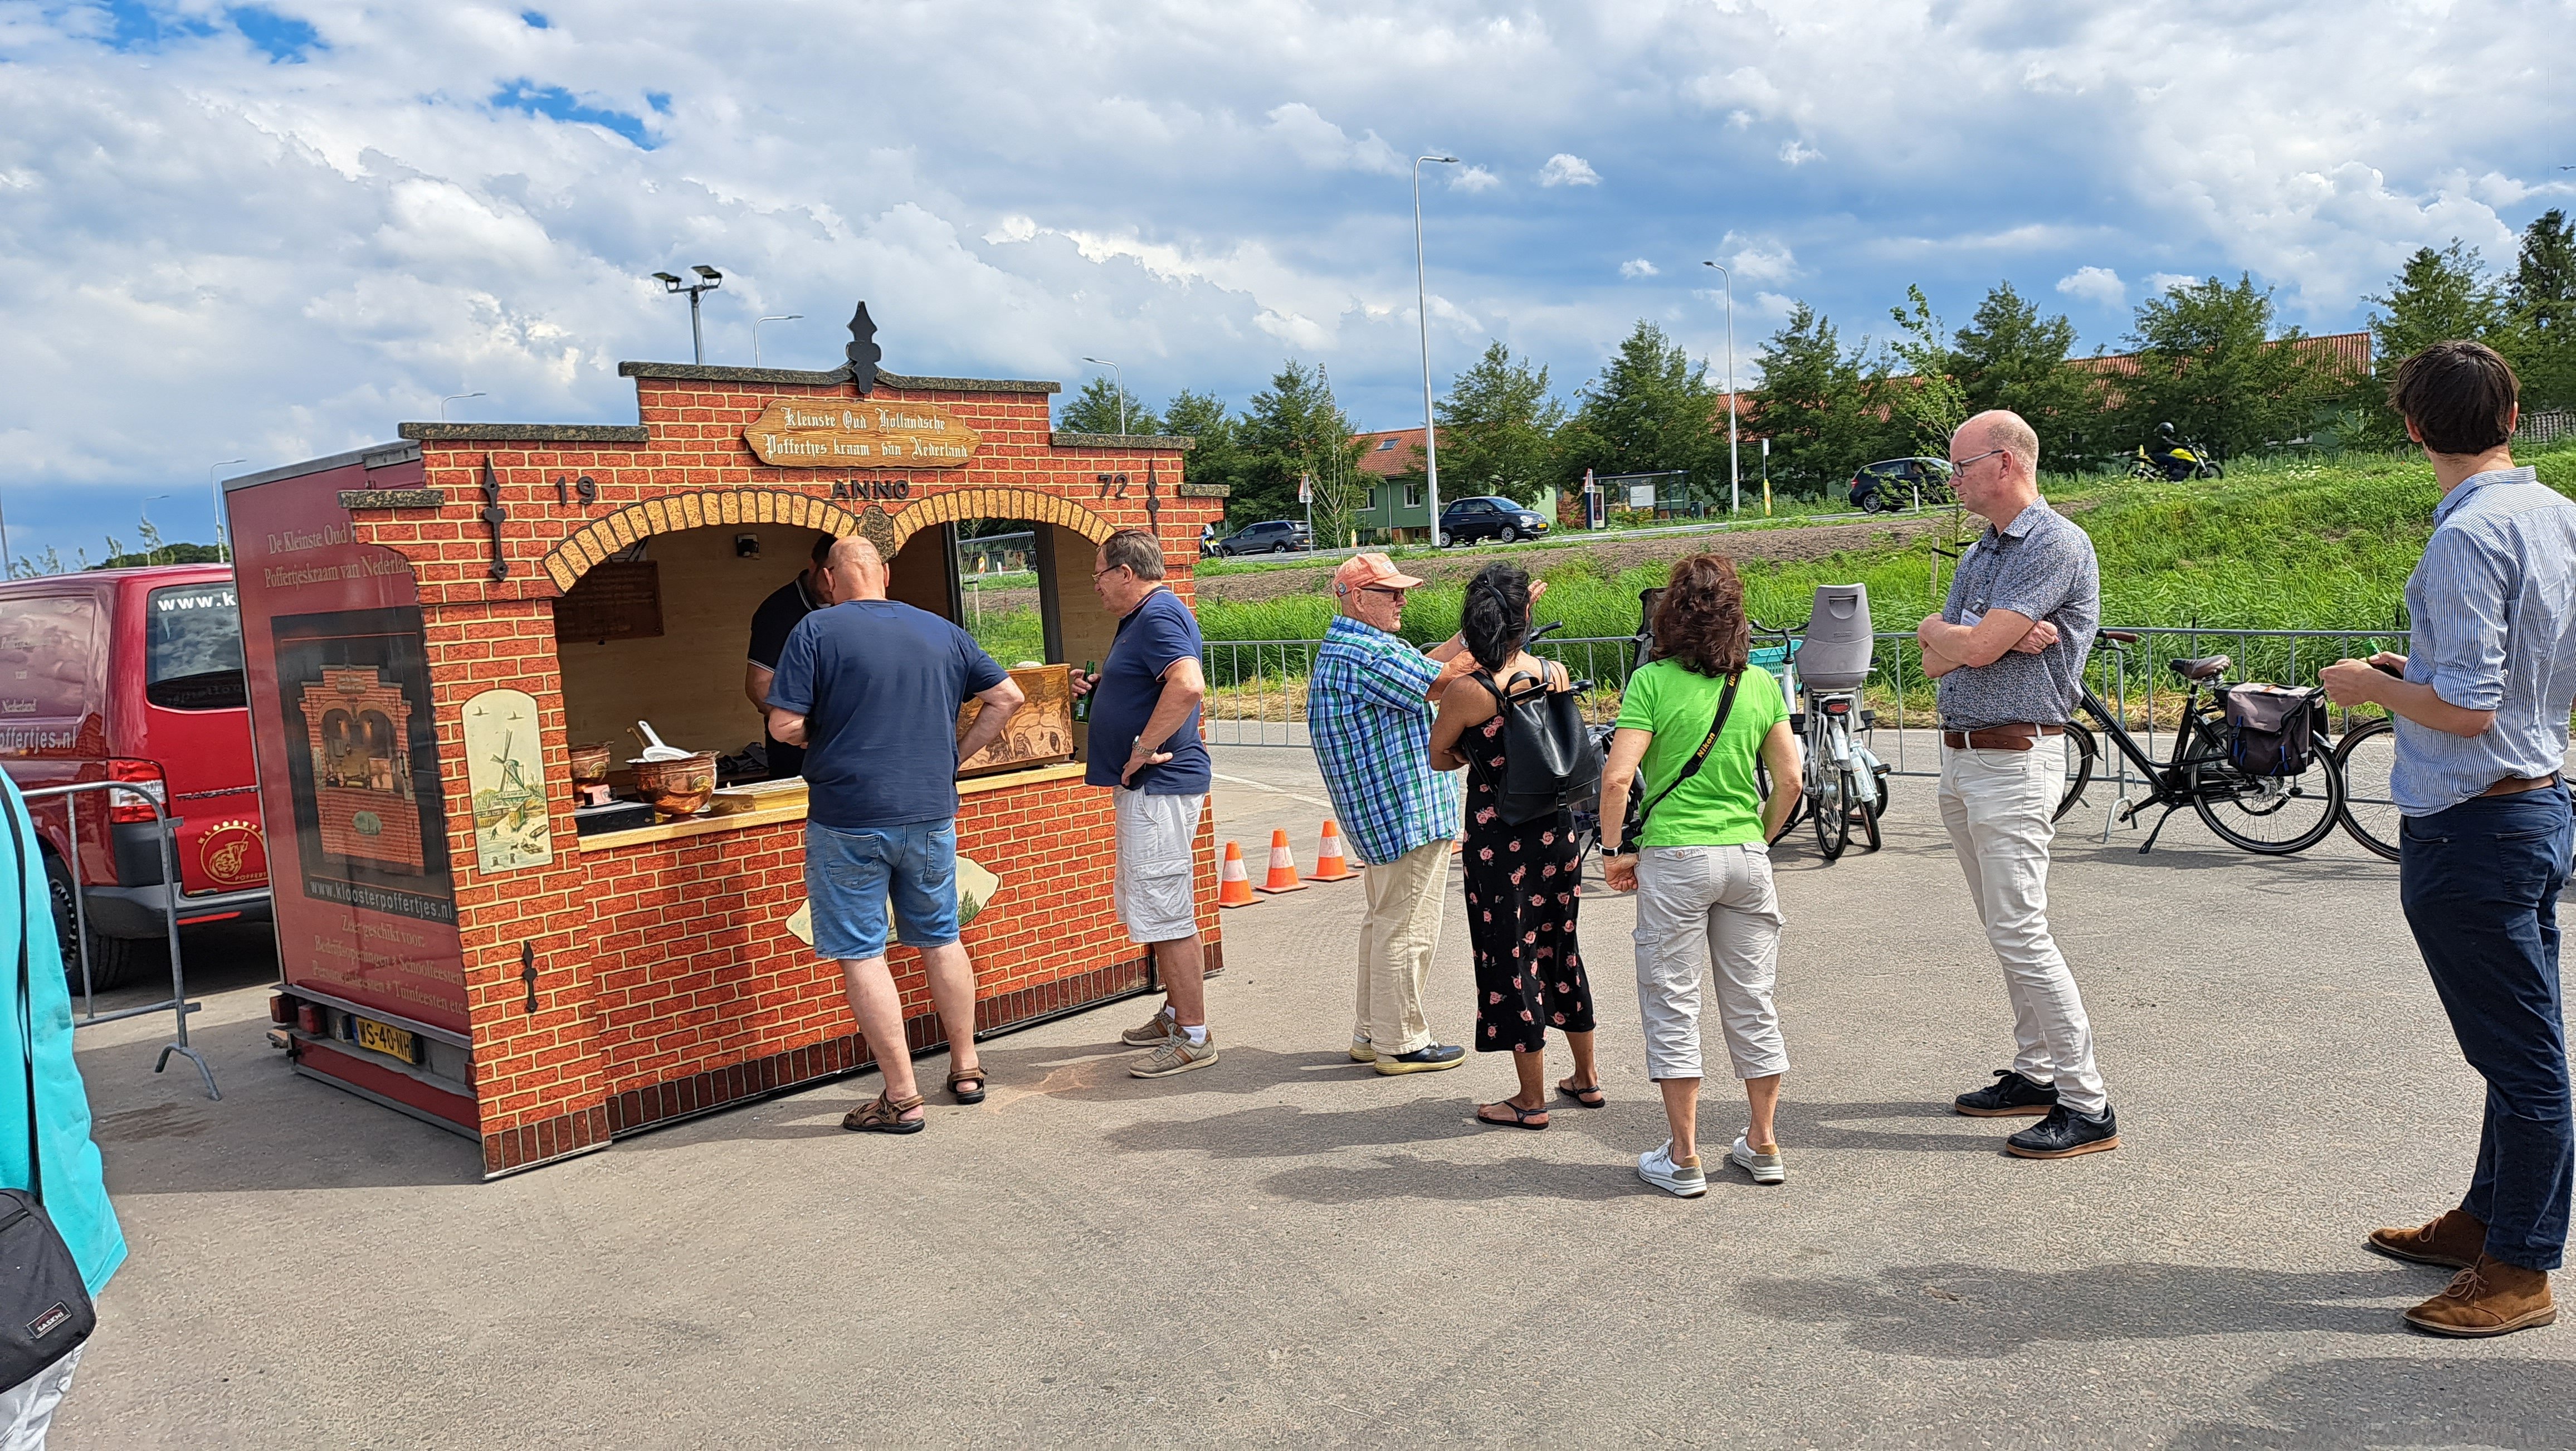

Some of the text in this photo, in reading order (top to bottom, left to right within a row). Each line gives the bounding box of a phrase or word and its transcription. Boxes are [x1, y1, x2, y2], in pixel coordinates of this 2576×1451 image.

[781, 407, 945, 435] Kleinste Oud Hollandsche
[762, 434, 827, 462] Poffertjes
[833, 437, 870, 456] kraam
[910, 436, 968, 460] Nederland
[555, 476, 596, 505] 19
[830, 480, 910, 500] ANNO
[1099, 474, 1128, 499] 72
[267, 534, 282, 554] De
[283, 529, 323, 552] Kleinste
[324, 522, 348, 545] Oud
[264, 553, 412, 591] Poffertjeskraam van Nederlan
[1697, 732, 1715, 758] Nikon
[309, 880, 453, 920] www.kloosterpoffertjes.nl
[364, 922, 399, 942] geschikt
[399, 953, 463, 986] Schoolfeesten
[392, 981, 447, 1010] Tuinfeesten
